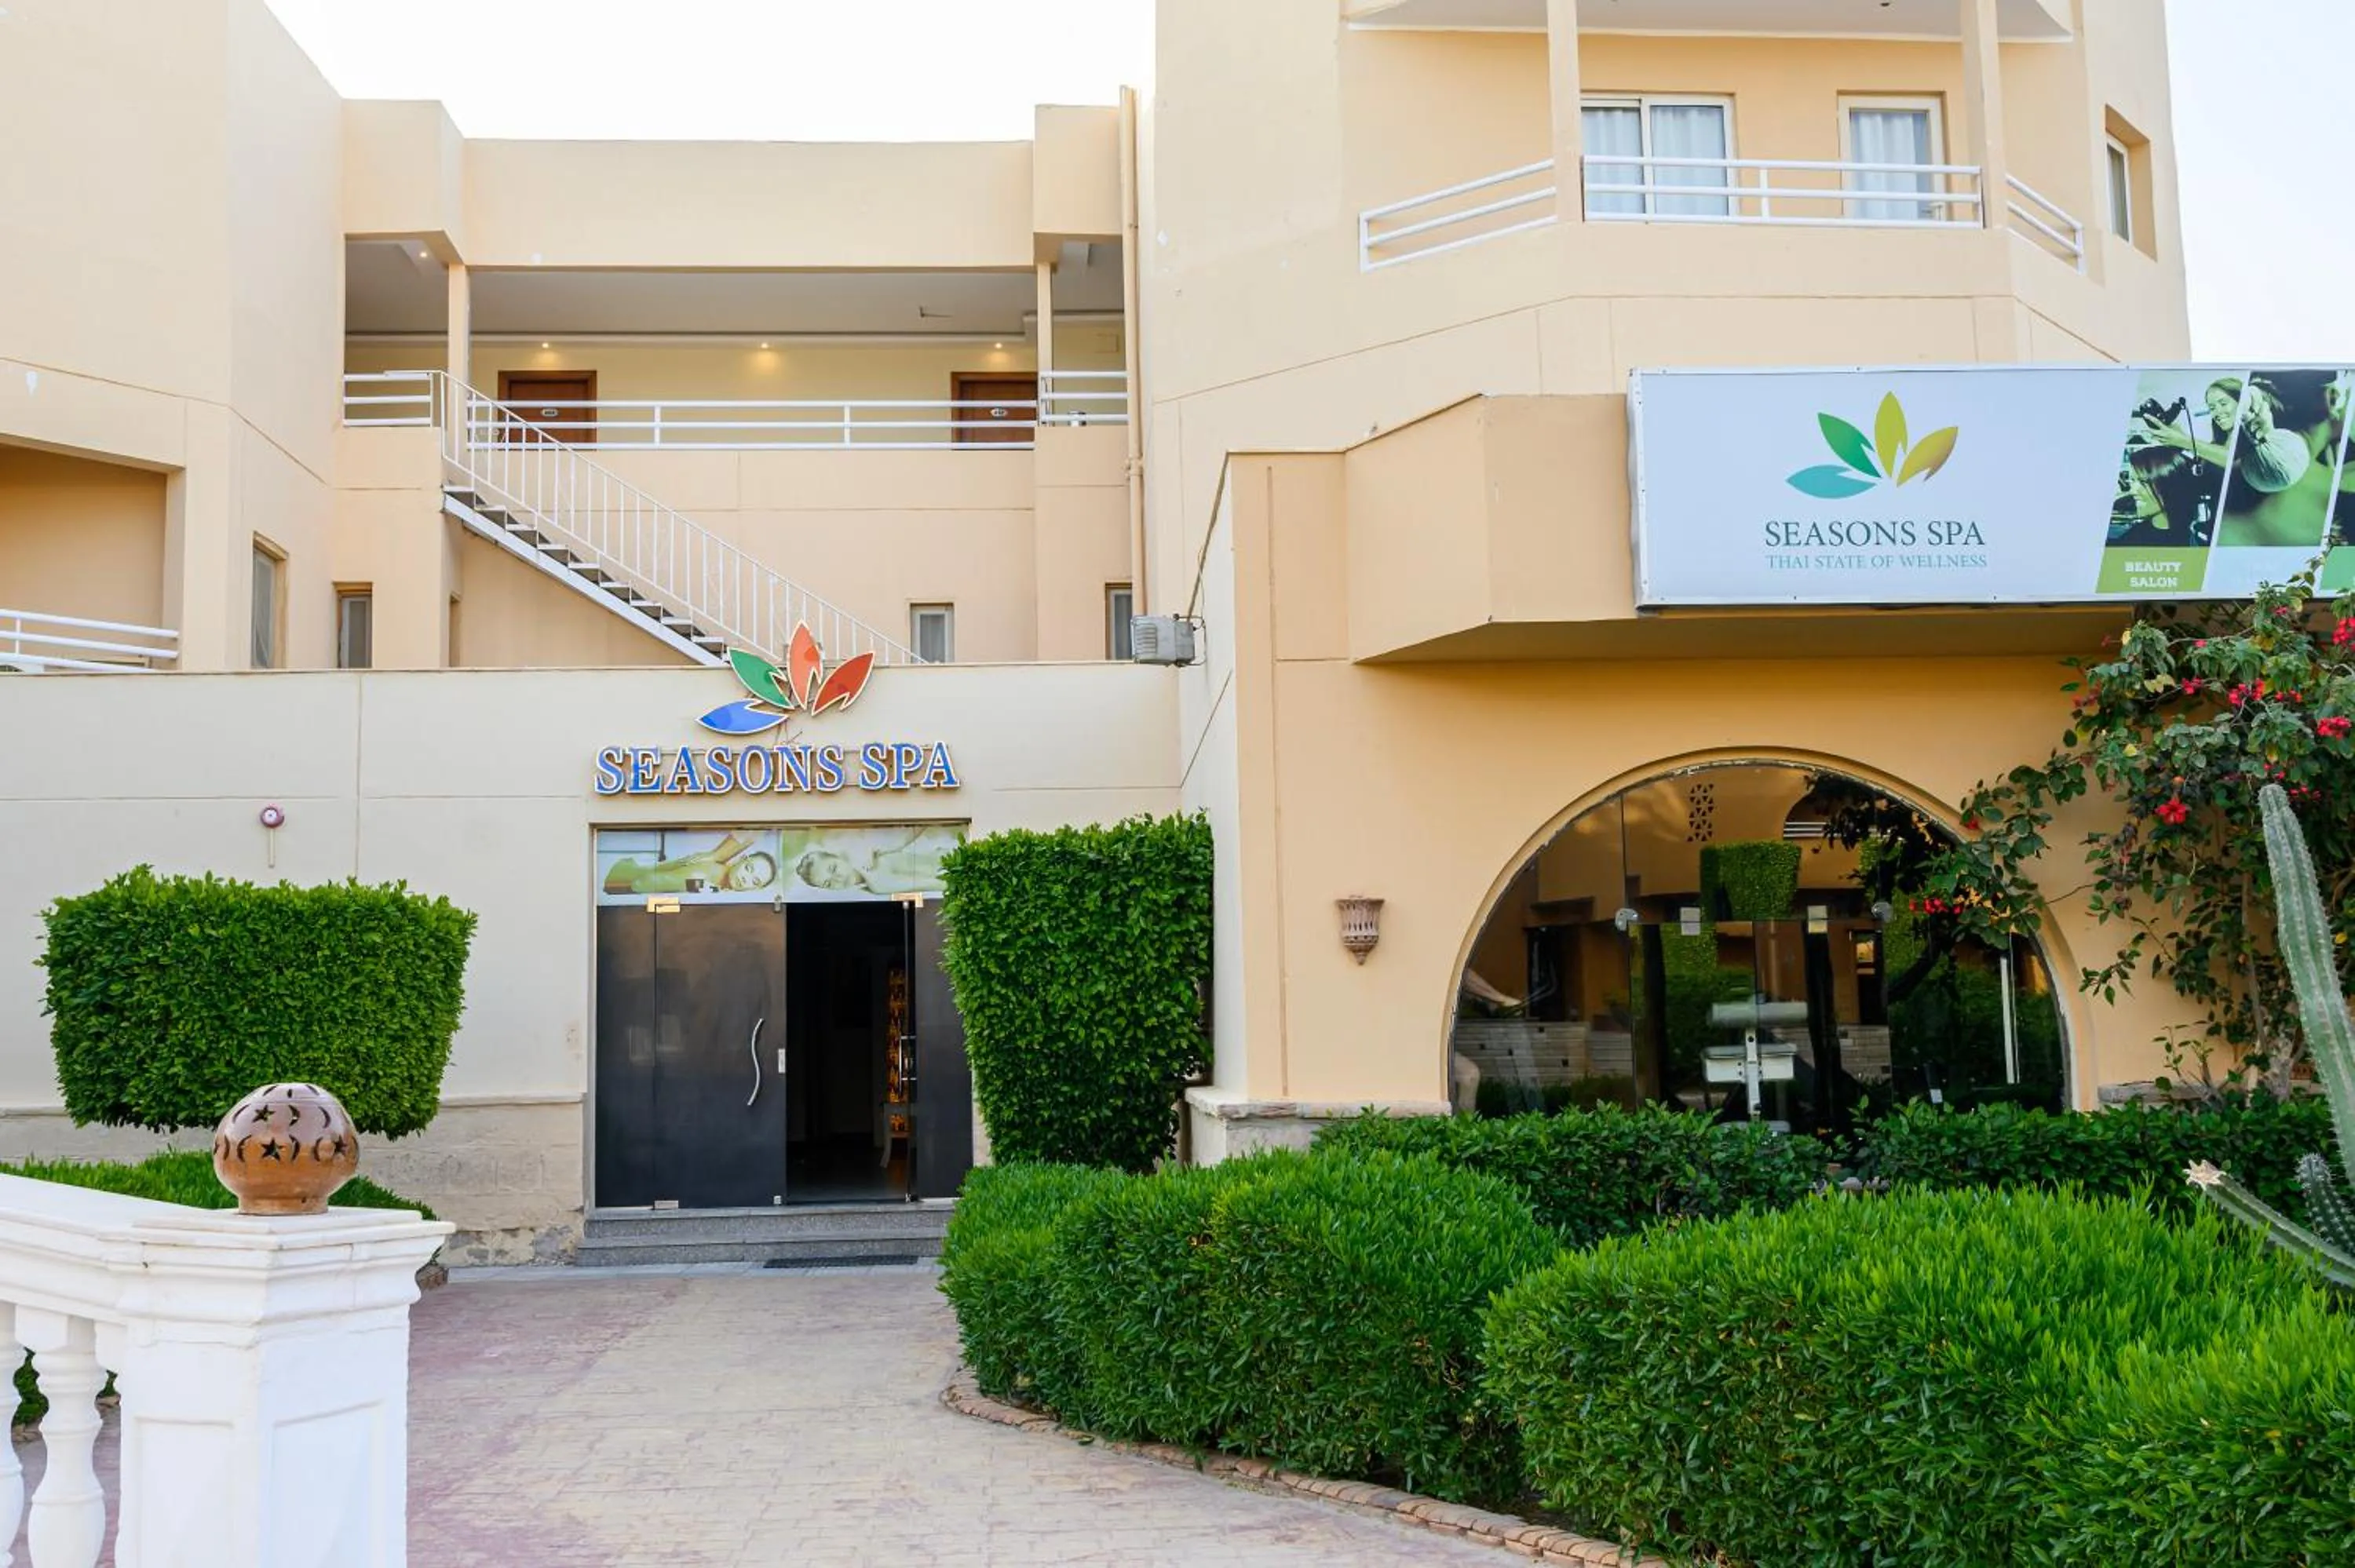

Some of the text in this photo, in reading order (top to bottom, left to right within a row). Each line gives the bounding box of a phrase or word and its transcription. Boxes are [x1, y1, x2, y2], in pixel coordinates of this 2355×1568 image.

[1765, 520, 1985, 546] SEASONS SPA
[1766, 554, 1988, 569] THAI STATE OF WELLNESS
[2124, 561, 2182, 572] BEAUTY
[2130, 577, 2178, 588] SALON
[595, 741, 959, 794] SEASONS SPA
